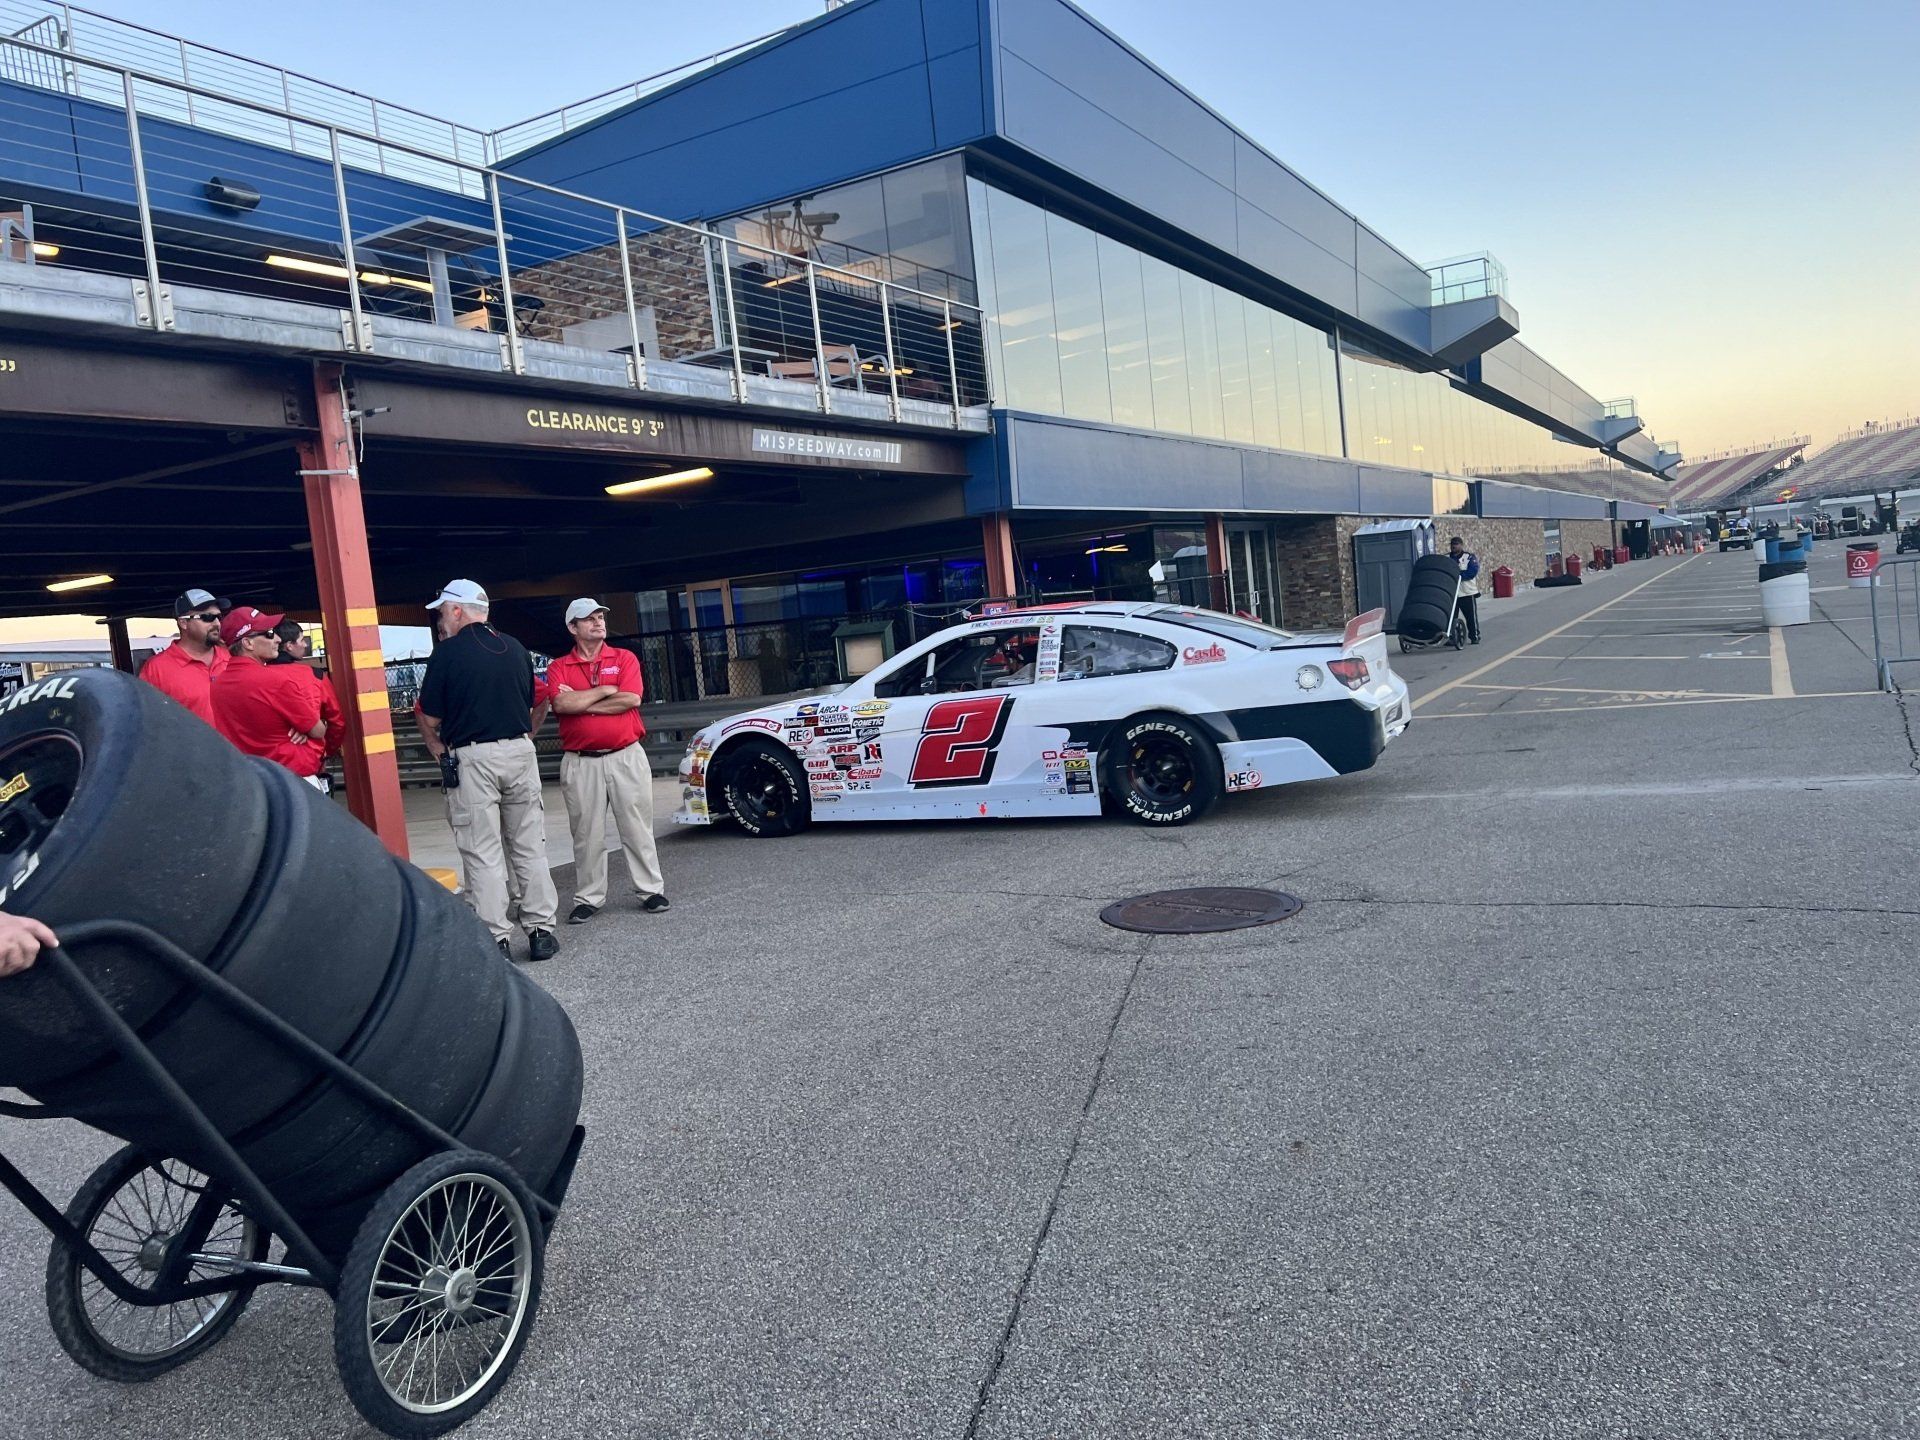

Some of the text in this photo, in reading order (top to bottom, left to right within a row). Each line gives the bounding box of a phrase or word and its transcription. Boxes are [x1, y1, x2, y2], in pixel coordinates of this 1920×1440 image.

[526, 409, 628, 434] CLEARANCE
[631, 418, 645, 435] 9'
[760, 433, 882, 459] MISPEEDWAY.com
[819, 705, 840, 714] ARCA
[853, 717, 884, 727] COMETIC
[1126, 722, 1193, 746] GENERAL
[826, 744, 857, 754] ARP
[908, 694, 1015, 789] 2
[1126, 797, 1192, 822] GENERAL
